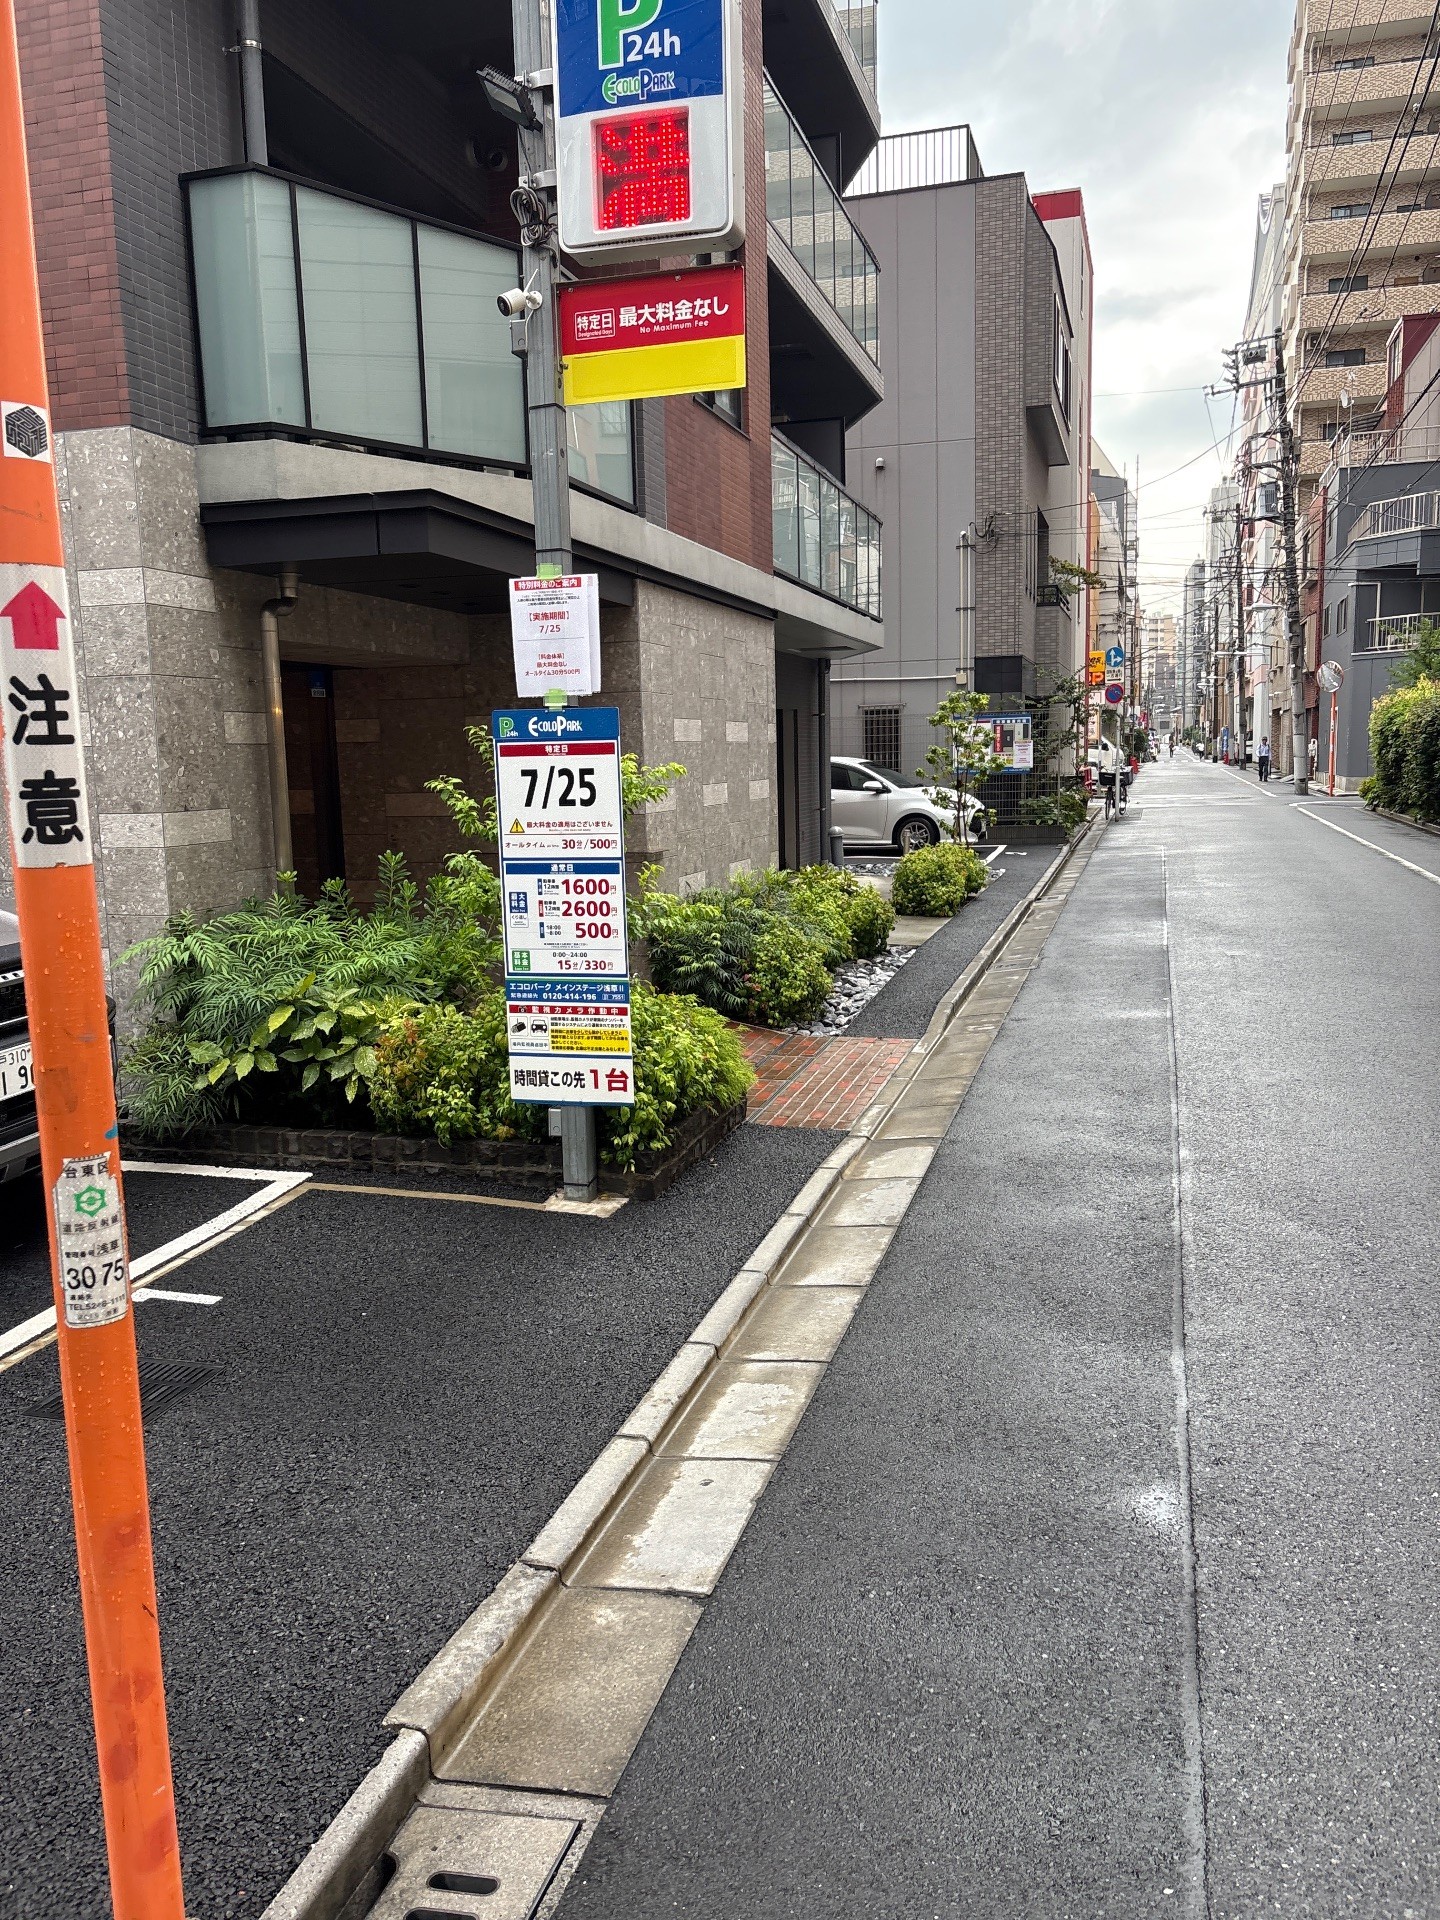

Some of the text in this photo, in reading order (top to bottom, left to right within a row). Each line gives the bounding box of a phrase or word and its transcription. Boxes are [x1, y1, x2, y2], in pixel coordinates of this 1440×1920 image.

[626, 28, 681, 62] 24h
[602, 118, 690, 230] 満
[619, 296, 729, 327] 最大料金なし
[577, 313, 612, 331] 特定日
[639, 319, 709, 334] No Maximum Fee
[519, 579, 578, 589] 特別料金のご案内
[539, 625, 561, 634] 7/25
[499, 717, 514, 737] P
[545, 745, 569, 753] 特定日
[8, 673, 84, 844] 注意
[521, 766, 597, 809] 7/25
[526, 820, 613, 829] 最大料金の適用はございません
[551, 864, 574, 872] 通常日
[510, 983, 551, 991] エコロパーク
[531, 1006, 619, 1016] 監視カメラ作動中
[8, 1049, 27, 1065] 310
[65, 1161, 108, 1180] 台東区
